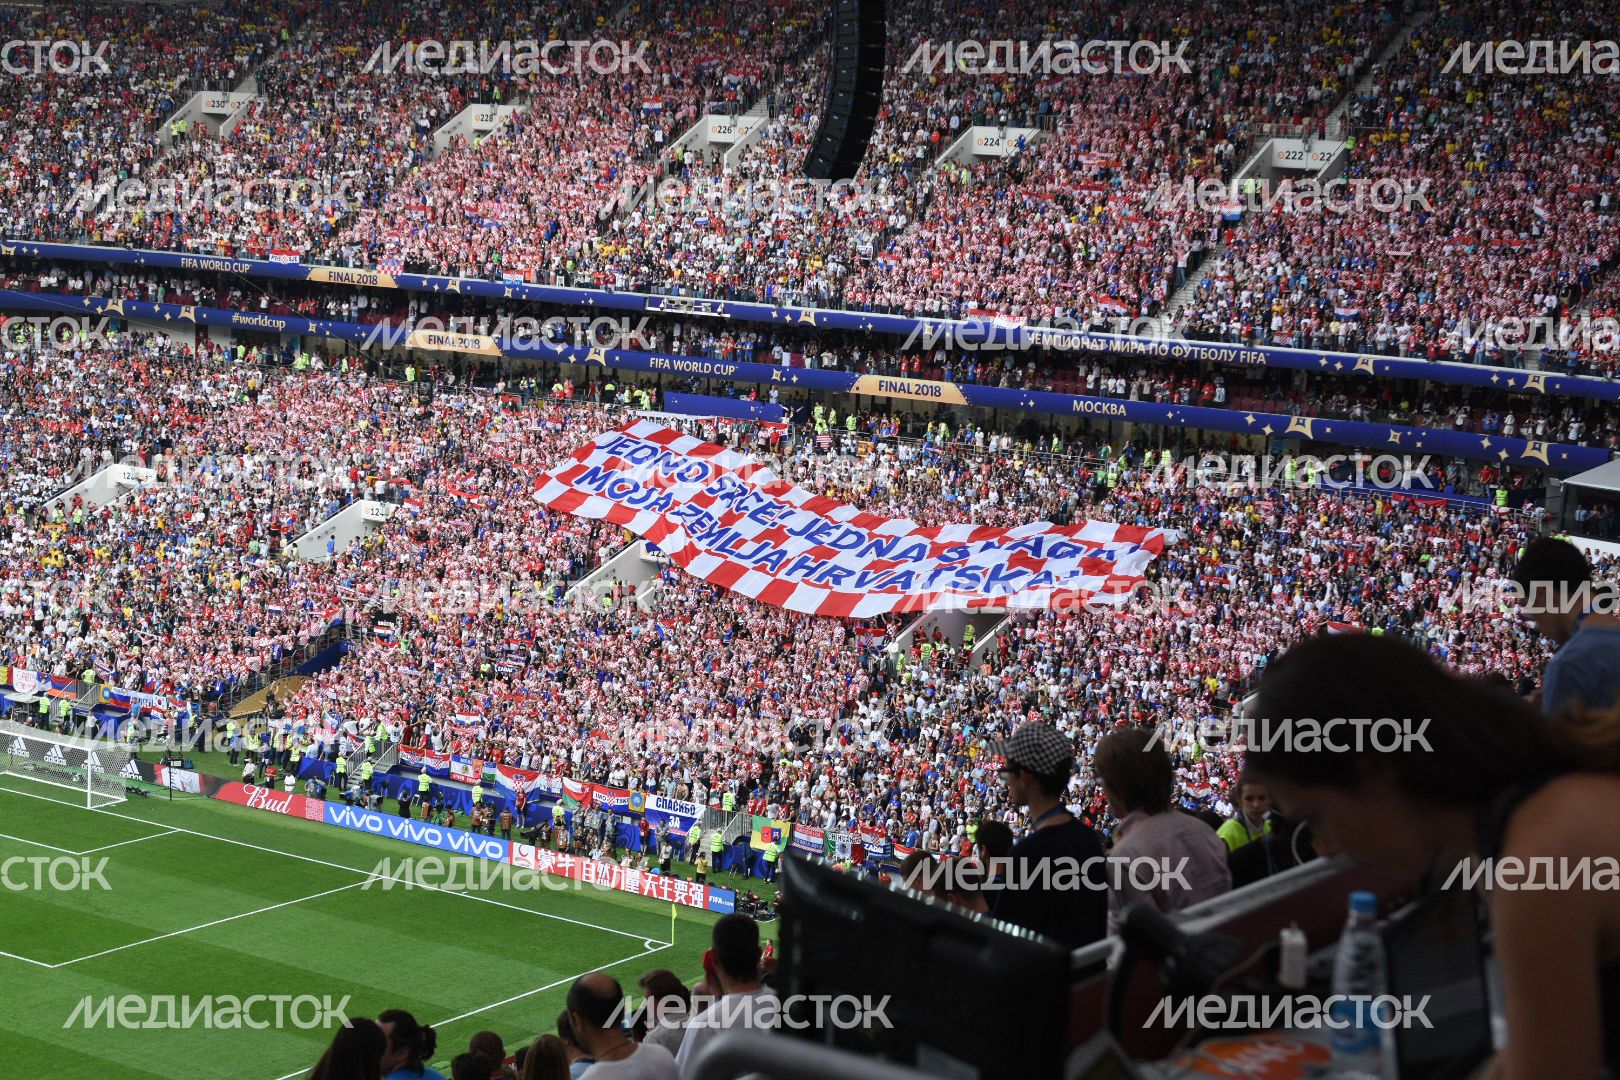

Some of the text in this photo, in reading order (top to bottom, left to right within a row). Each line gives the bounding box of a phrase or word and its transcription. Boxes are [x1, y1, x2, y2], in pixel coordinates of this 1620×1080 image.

[211, 100, 226, 109] 230
[480, 113, 494, 122] 228
[717, 125, 732, 134] 226
[983, 137, 1000, 147] 224
[1284, 150, 1304, 160] 222
[181, 257, 250, 273] FIFA WORLD CUP
[328, 270, 378, 286] FINAL 2018
[231, 312, 286, 331] #worldcup
[427, 334, 481, 349] FINAL 2018
[1027, 331, 1267, 365] ЧЕМПИОНАТ МИРА ПО ФУТБОЛУ FIFA
[649, 356, 736, 377] FIFA WORLD CUP
[878, 380, 942, 397] FINAL 2018
[1072, 399, 1127, 416] МОСКВА
[573, 465, 674, 513] MOJA
[596, 434, 709, 484] JEDNO
[786, 517, 929, 563] JEDNA
[243, 783, 293, 814] Bud
[655, 796, 696, 816] СПАСИБО
[668, 815, 680, 829] ЗА
[330, 806, 503, 858] vivo vivo vivo
[582, 860, 641, 894] 自然力量
